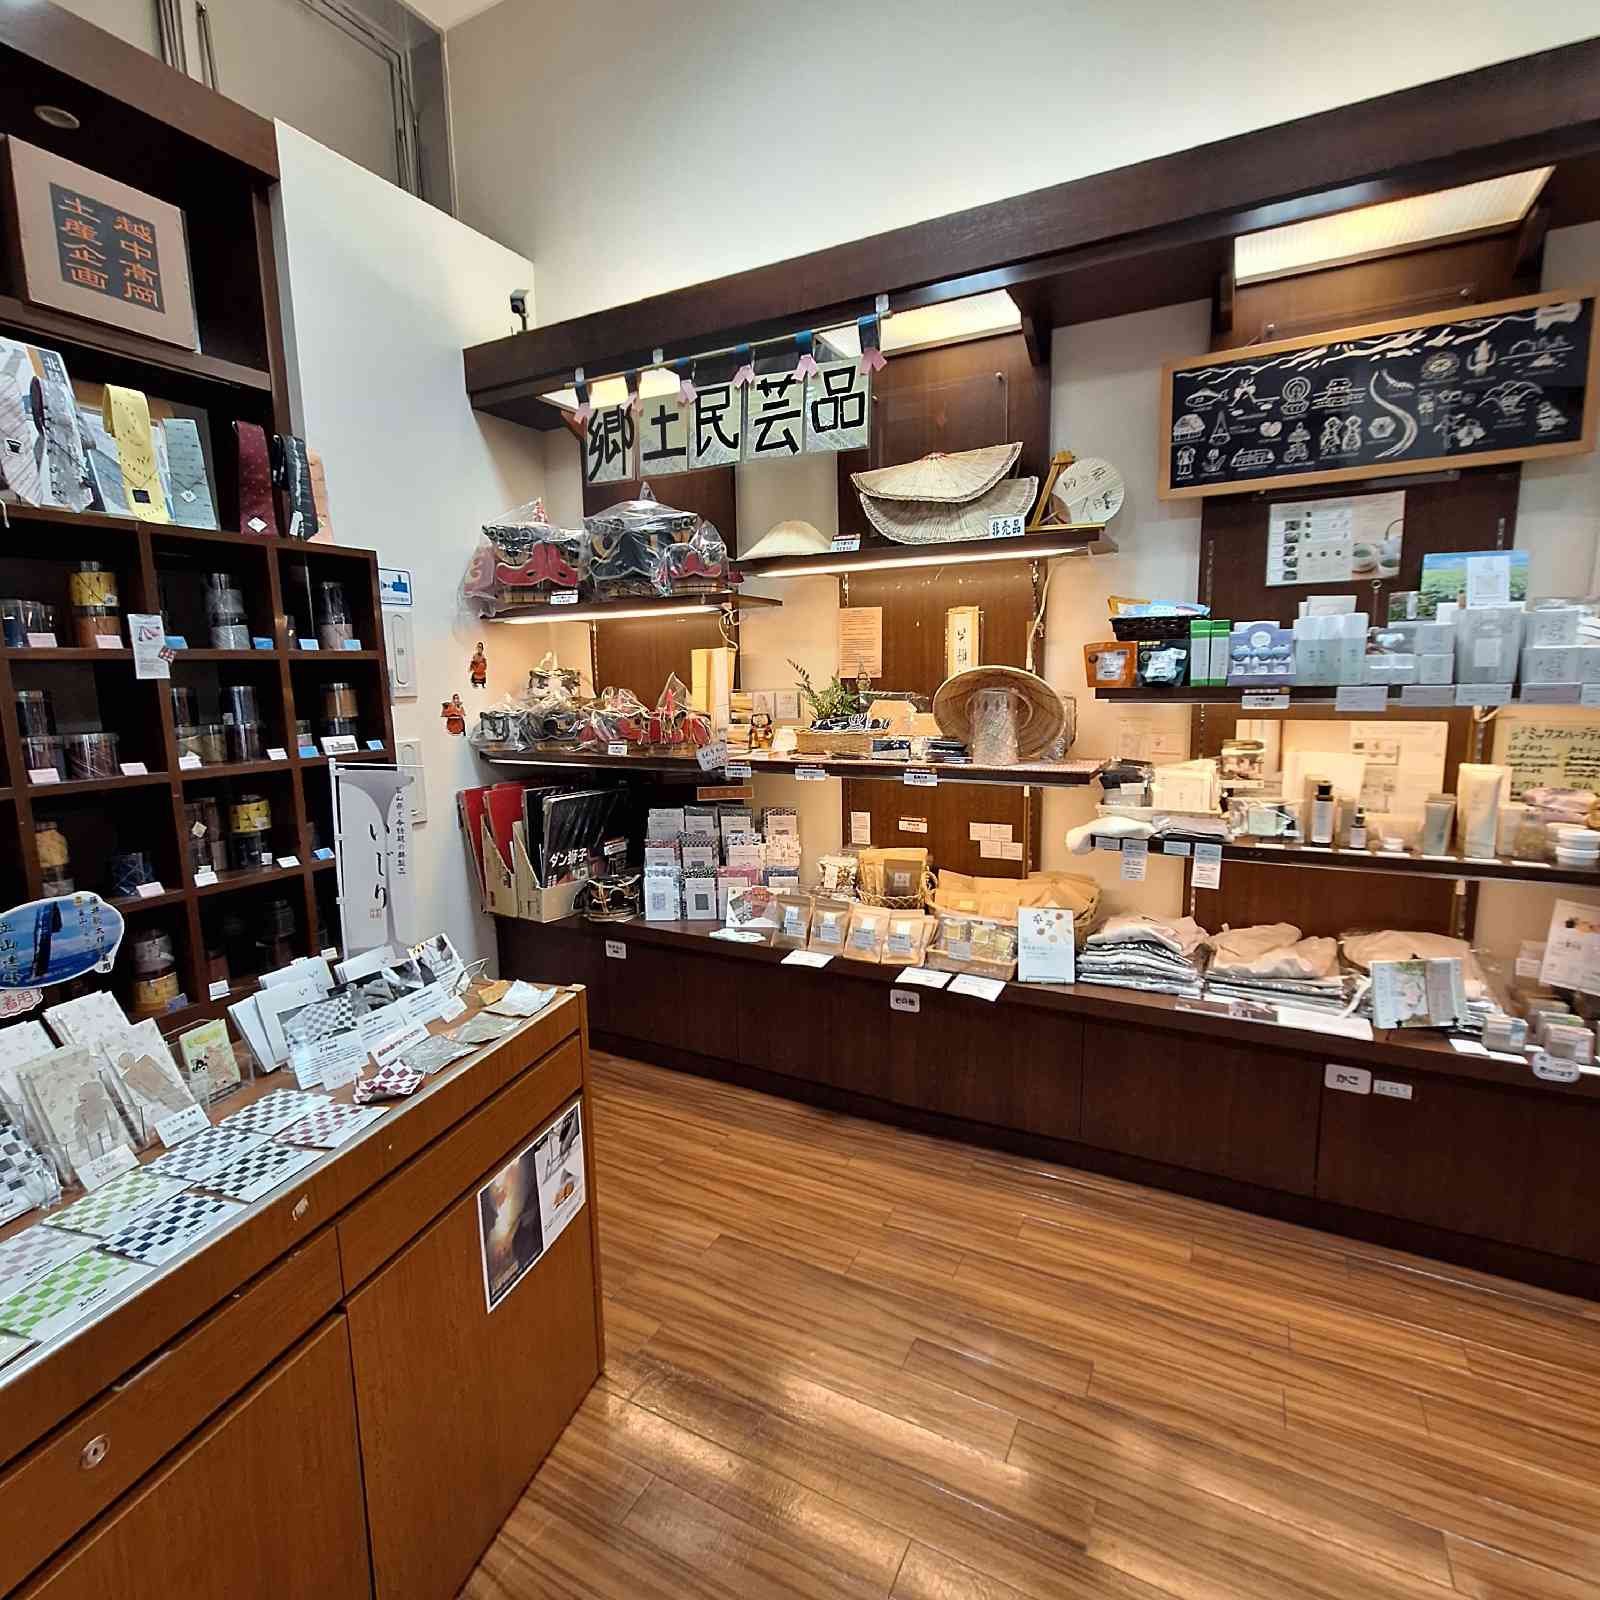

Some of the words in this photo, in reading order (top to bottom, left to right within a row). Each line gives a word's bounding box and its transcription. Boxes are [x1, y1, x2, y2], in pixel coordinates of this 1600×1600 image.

[587, 365, 865, 482] 郷土民芸品
[992, 518, 1021, 537] 非売品
[549, 847, 588, 868] ダン獅子
